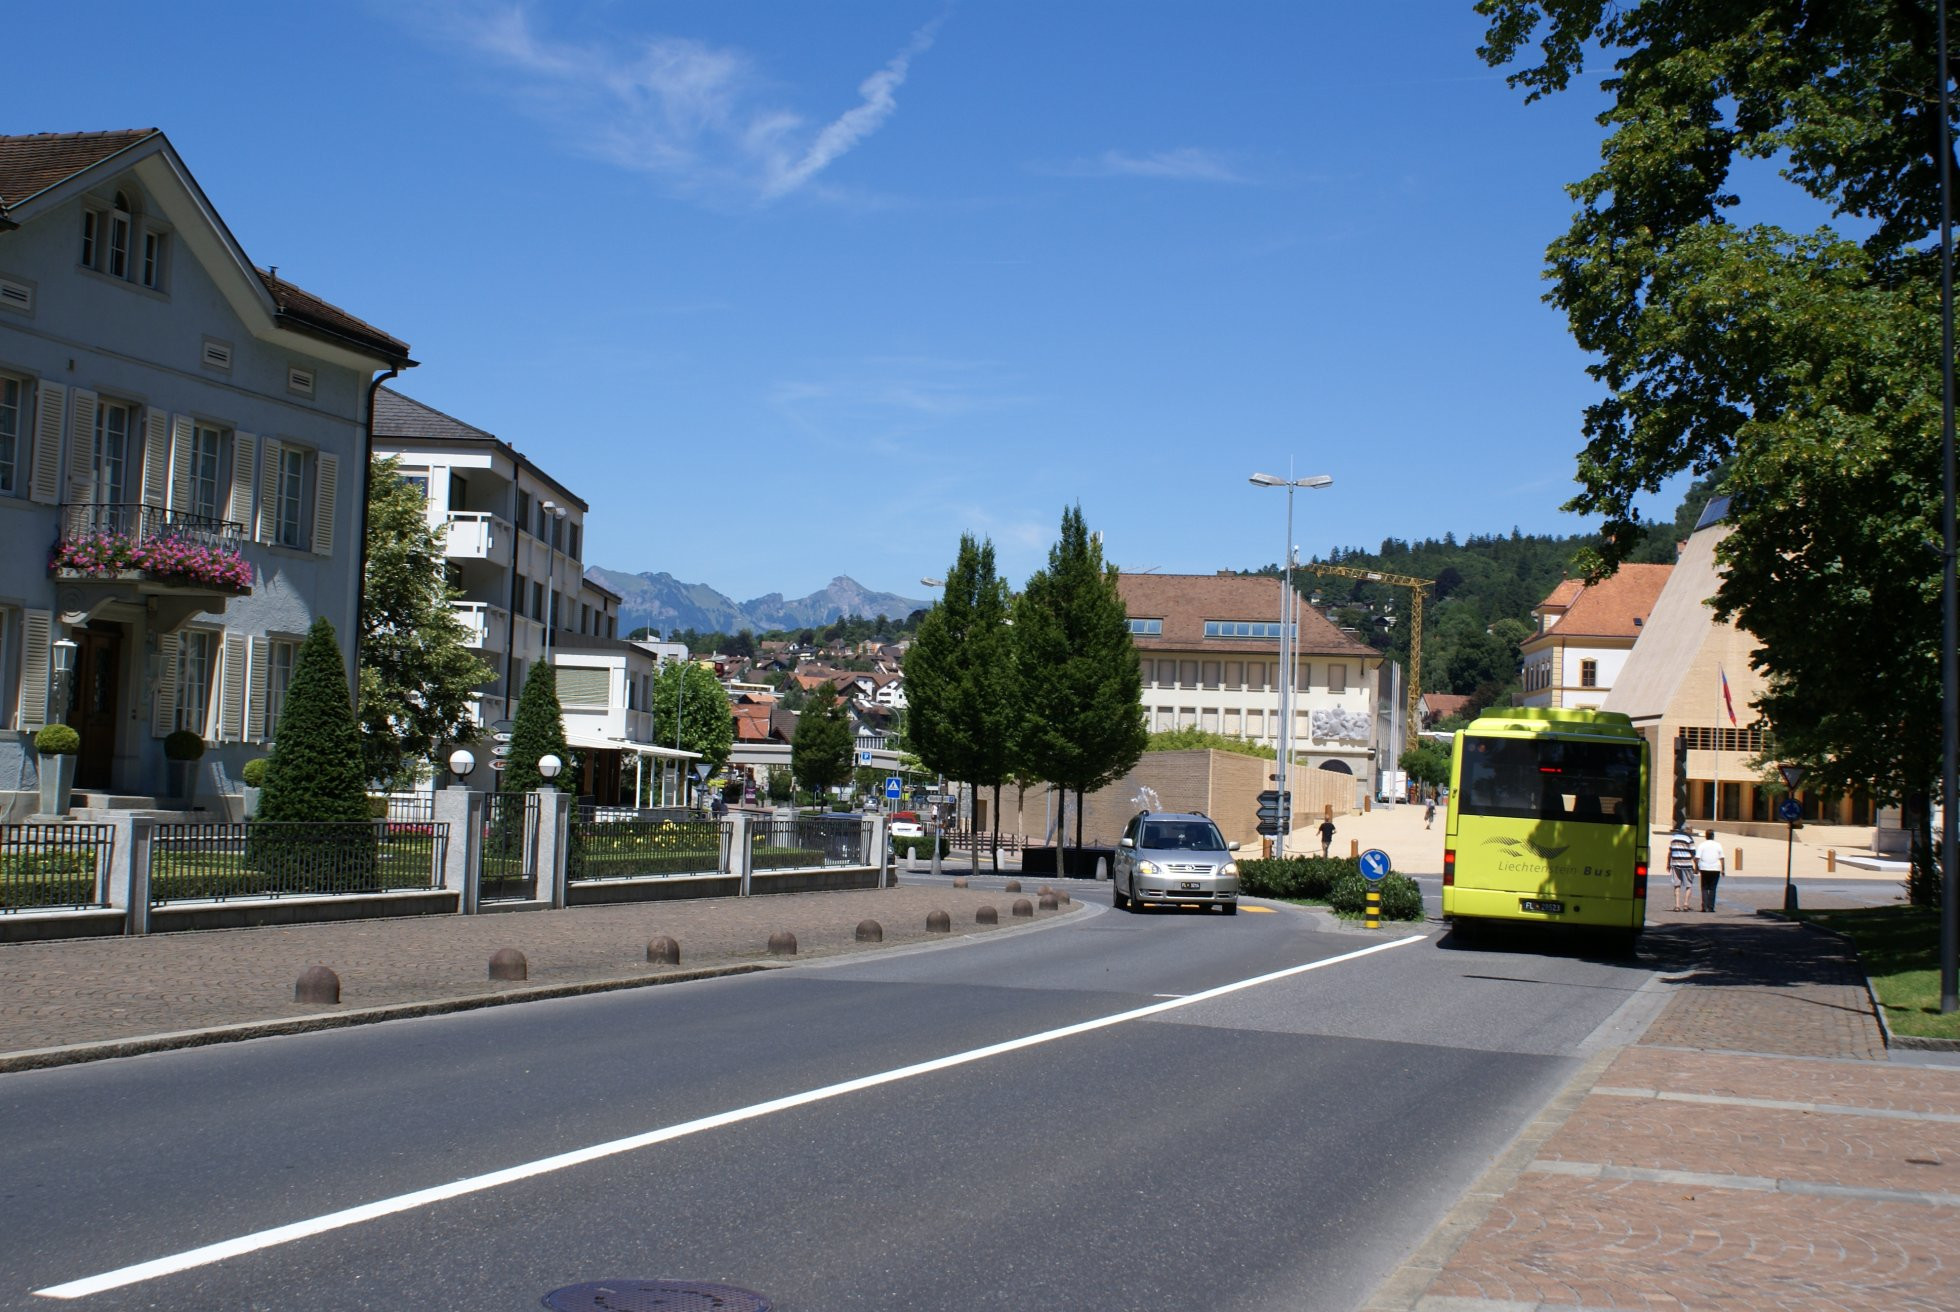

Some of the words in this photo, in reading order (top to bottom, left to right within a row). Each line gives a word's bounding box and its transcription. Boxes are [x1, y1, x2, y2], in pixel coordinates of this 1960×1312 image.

[1498, 861, 1577, 875] Liechtenstein
[1583, 866, 1612, 877] Bus
[1525, 901, 1534, 910] FL
